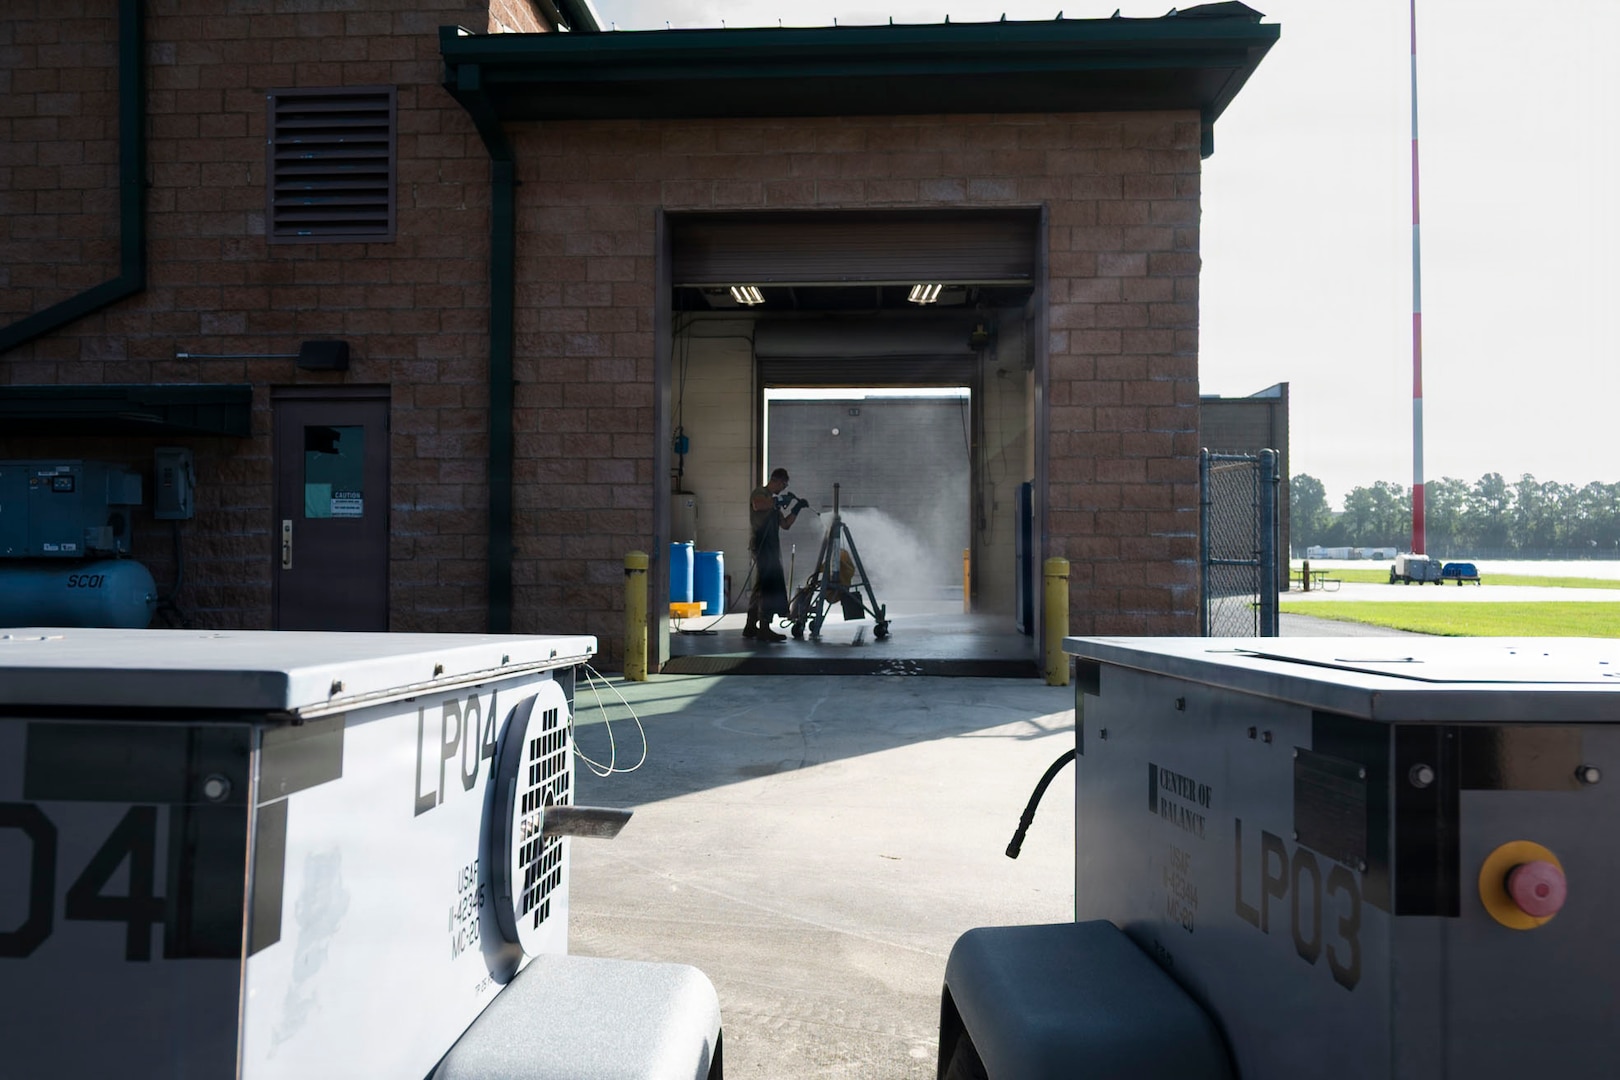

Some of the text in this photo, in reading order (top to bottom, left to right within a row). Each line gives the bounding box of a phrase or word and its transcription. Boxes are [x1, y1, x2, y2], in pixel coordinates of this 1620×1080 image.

[414, 688, 498, 818] LP04
[1160, 768, 1212, 809] CENTER OF
[1161, 797, 1205, 840] BALANCE
[457, 858, 480, 895] USAF
[1235, 817, 1362, 993] LP03
[451, 915, 480, 962] MC-20
